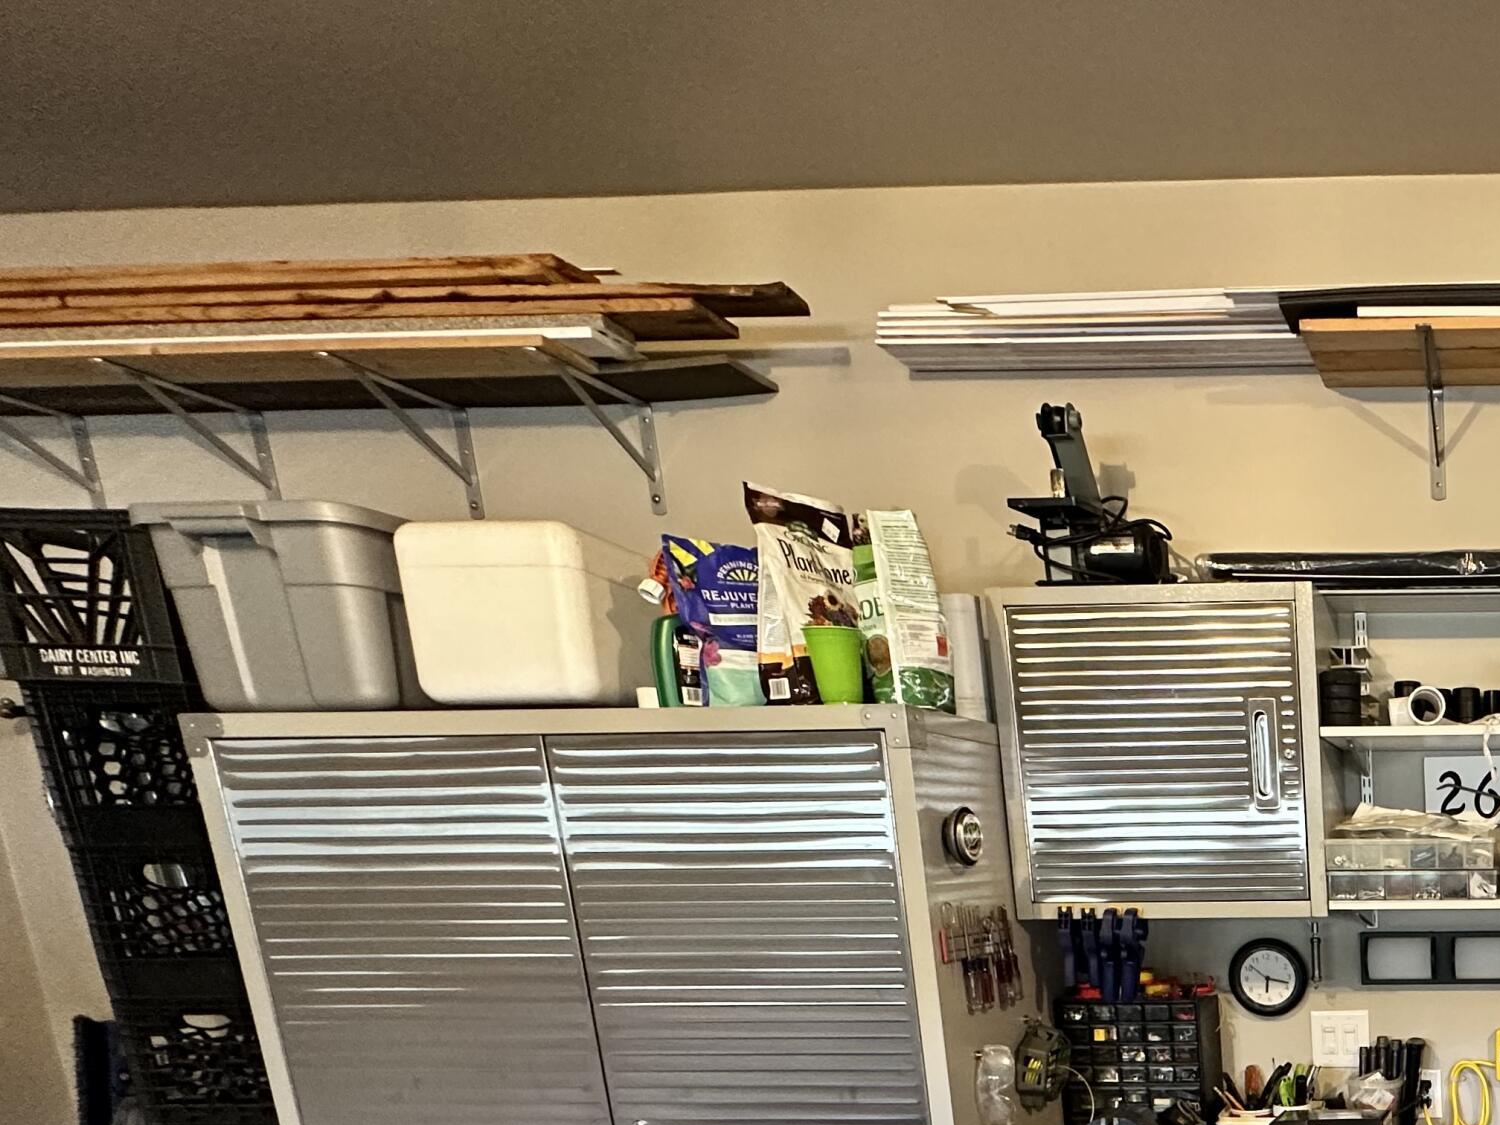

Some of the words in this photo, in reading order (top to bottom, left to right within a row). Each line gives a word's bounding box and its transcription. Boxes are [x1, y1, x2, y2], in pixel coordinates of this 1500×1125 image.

[38, 648, 73, 663] DAIRY
[76, 649, 118, 664] CENTER
[119, 650, 140, 665] INC
